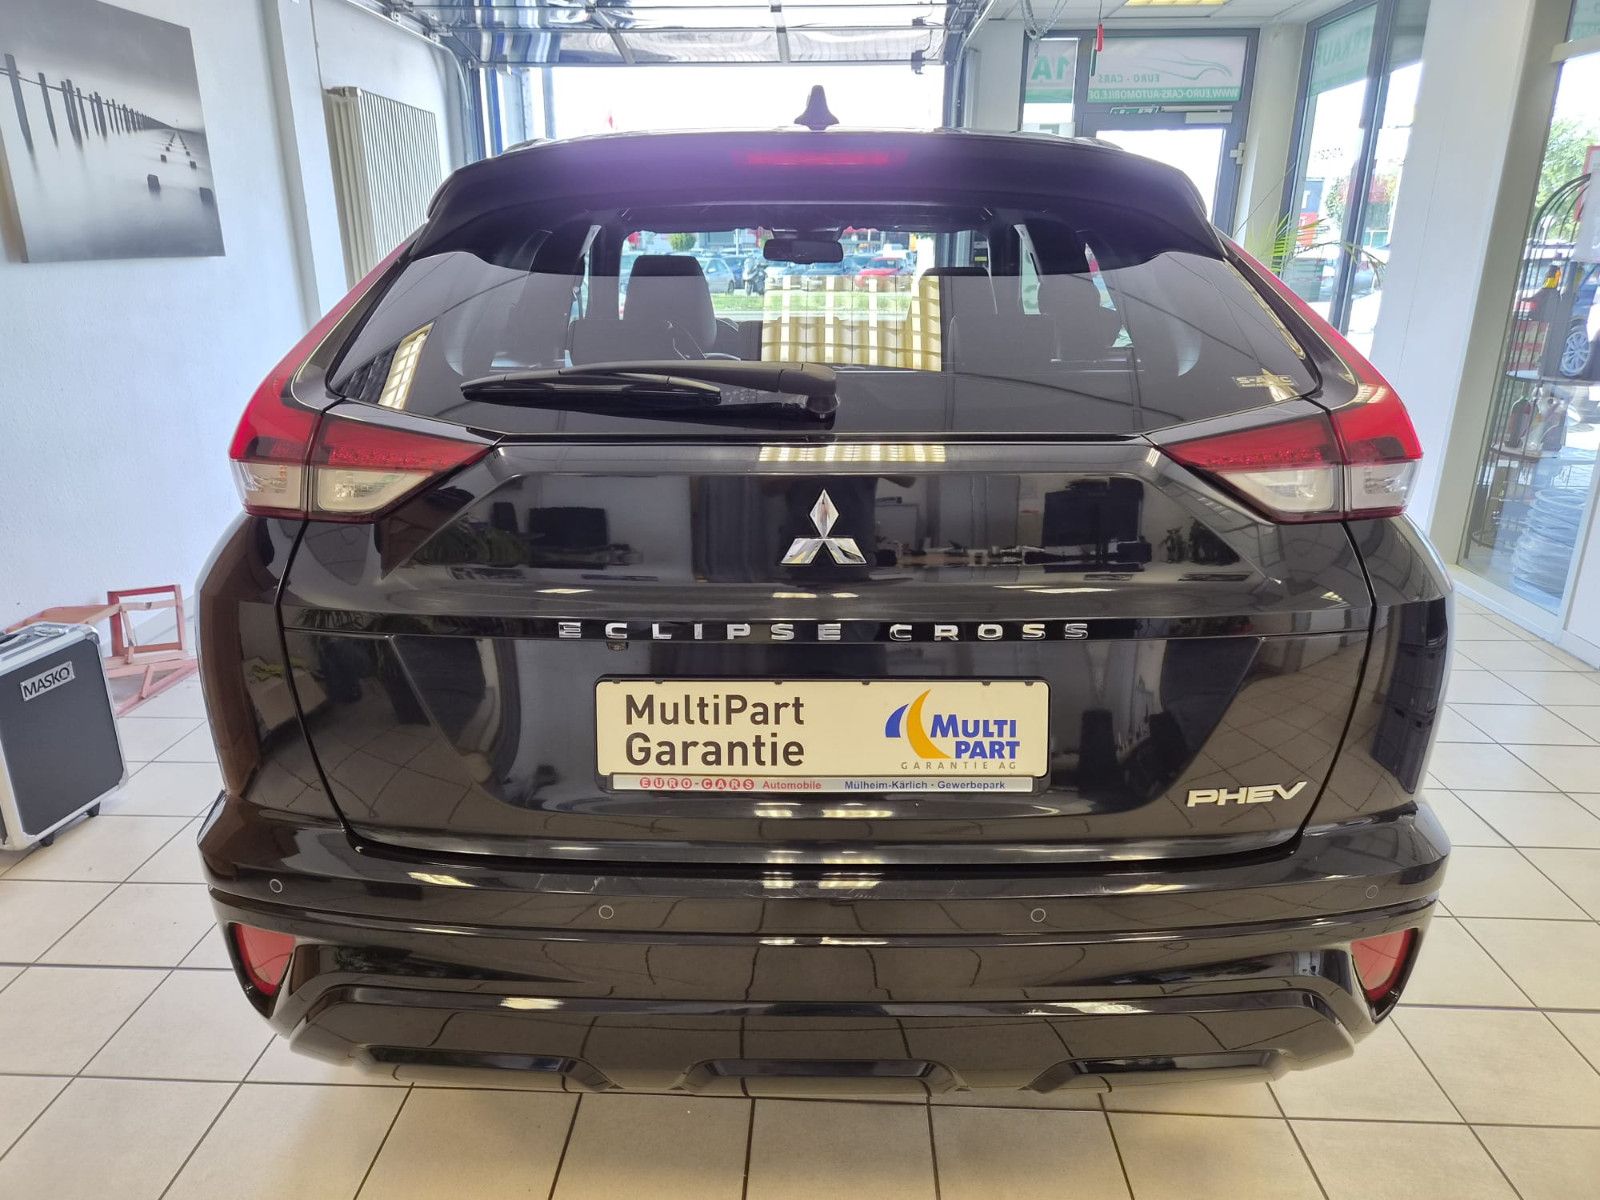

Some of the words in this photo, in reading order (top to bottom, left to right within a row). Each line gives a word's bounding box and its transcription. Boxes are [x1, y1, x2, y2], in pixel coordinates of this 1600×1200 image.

[558, 621, 842, 641] ECLIPSE
[889, 623, 1089, 641] CROSS
[23, 667, 70, 698] MASKO
[624, 694, 805, 726] MultiPart
[929, 713, 1017, 738] MULTI
[624, 732, 804, 767] Garantie
[955, 740, 1020, 759] PART
[900, 761, 988, 770] GARANTIE
[999, 761, 1016, 770] AG
[762, 780, 821, 790] Automobile
[844, 780, 928, 790] Mülheim-Kärlich
[937, 781, 1005, 791] Gewerbepark
[1187, 781, 1307, 807] PHEV
